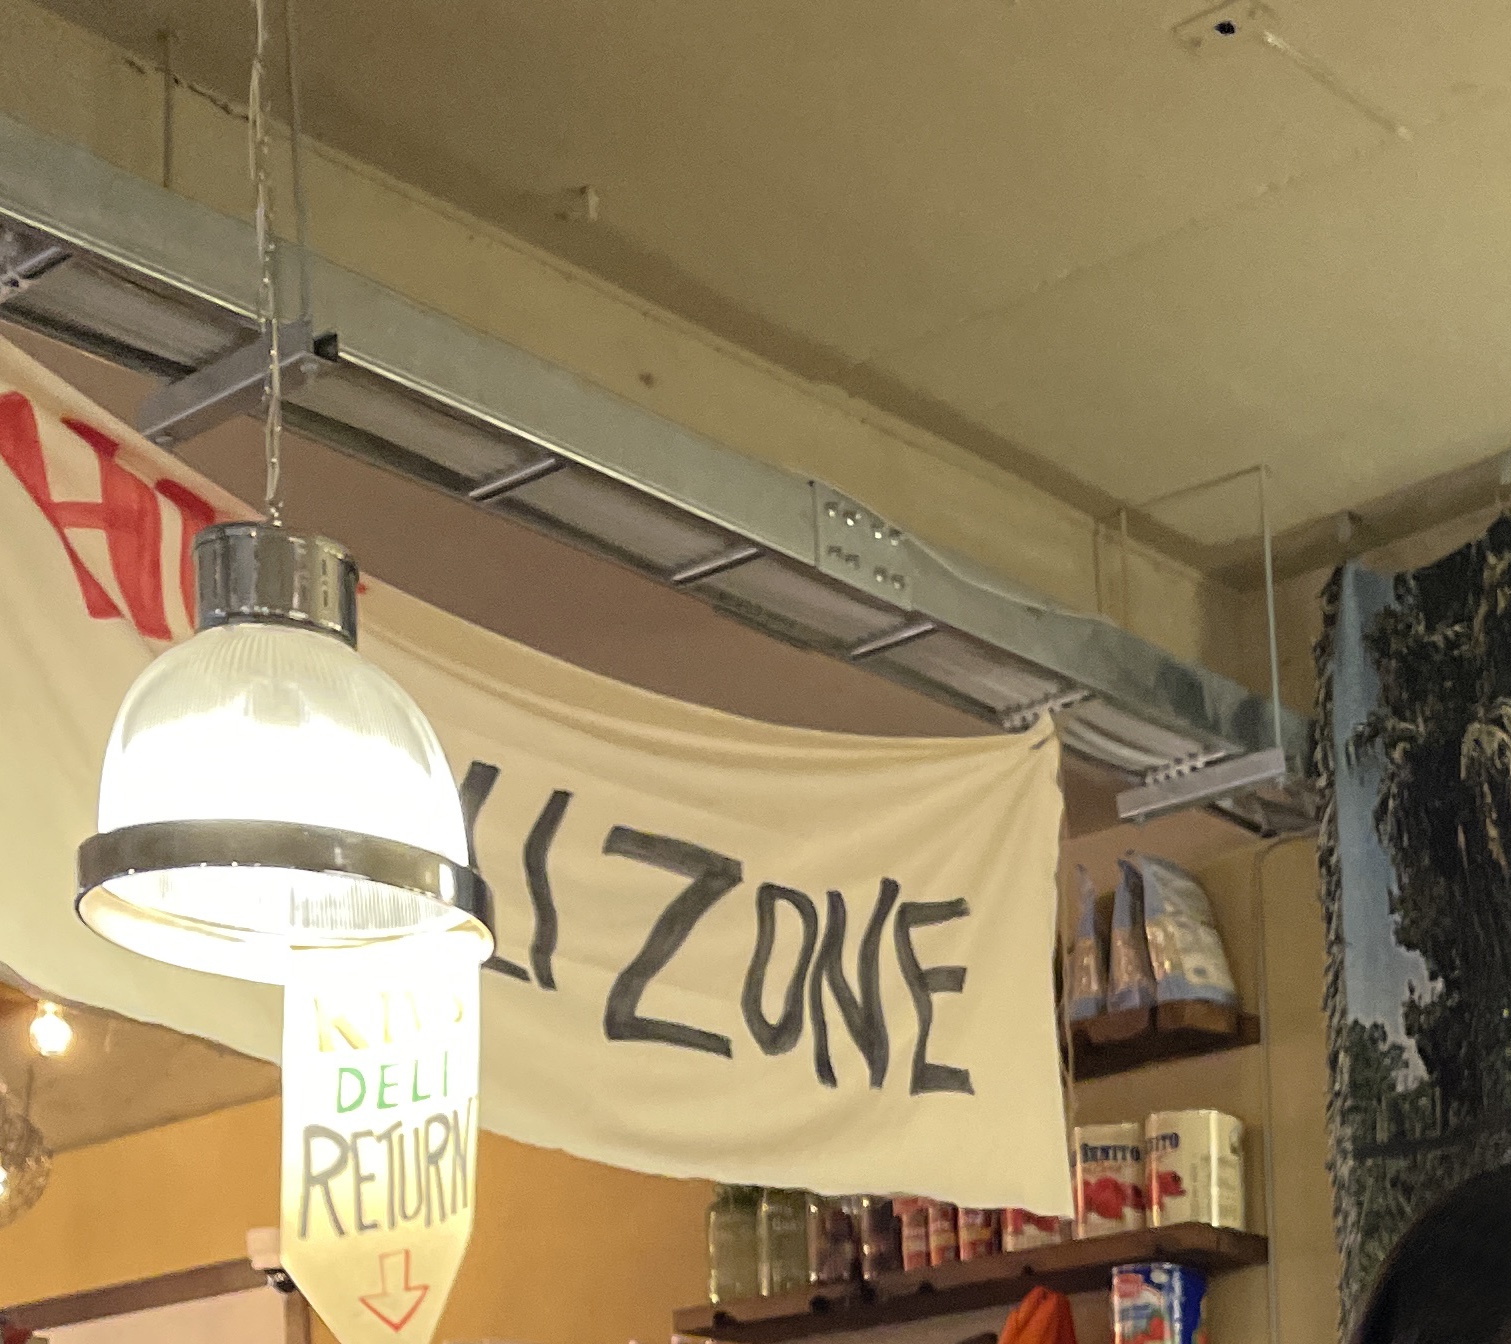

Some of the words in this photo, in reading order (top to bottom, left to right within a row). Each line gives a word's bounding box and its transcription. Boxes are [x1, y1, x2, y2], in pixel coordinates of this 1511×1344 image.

[602, 825, 975, 1096] ZONE
[337, 1051, 447, 1114] DELI
[299, 1096, 472, 1240] RETURN
